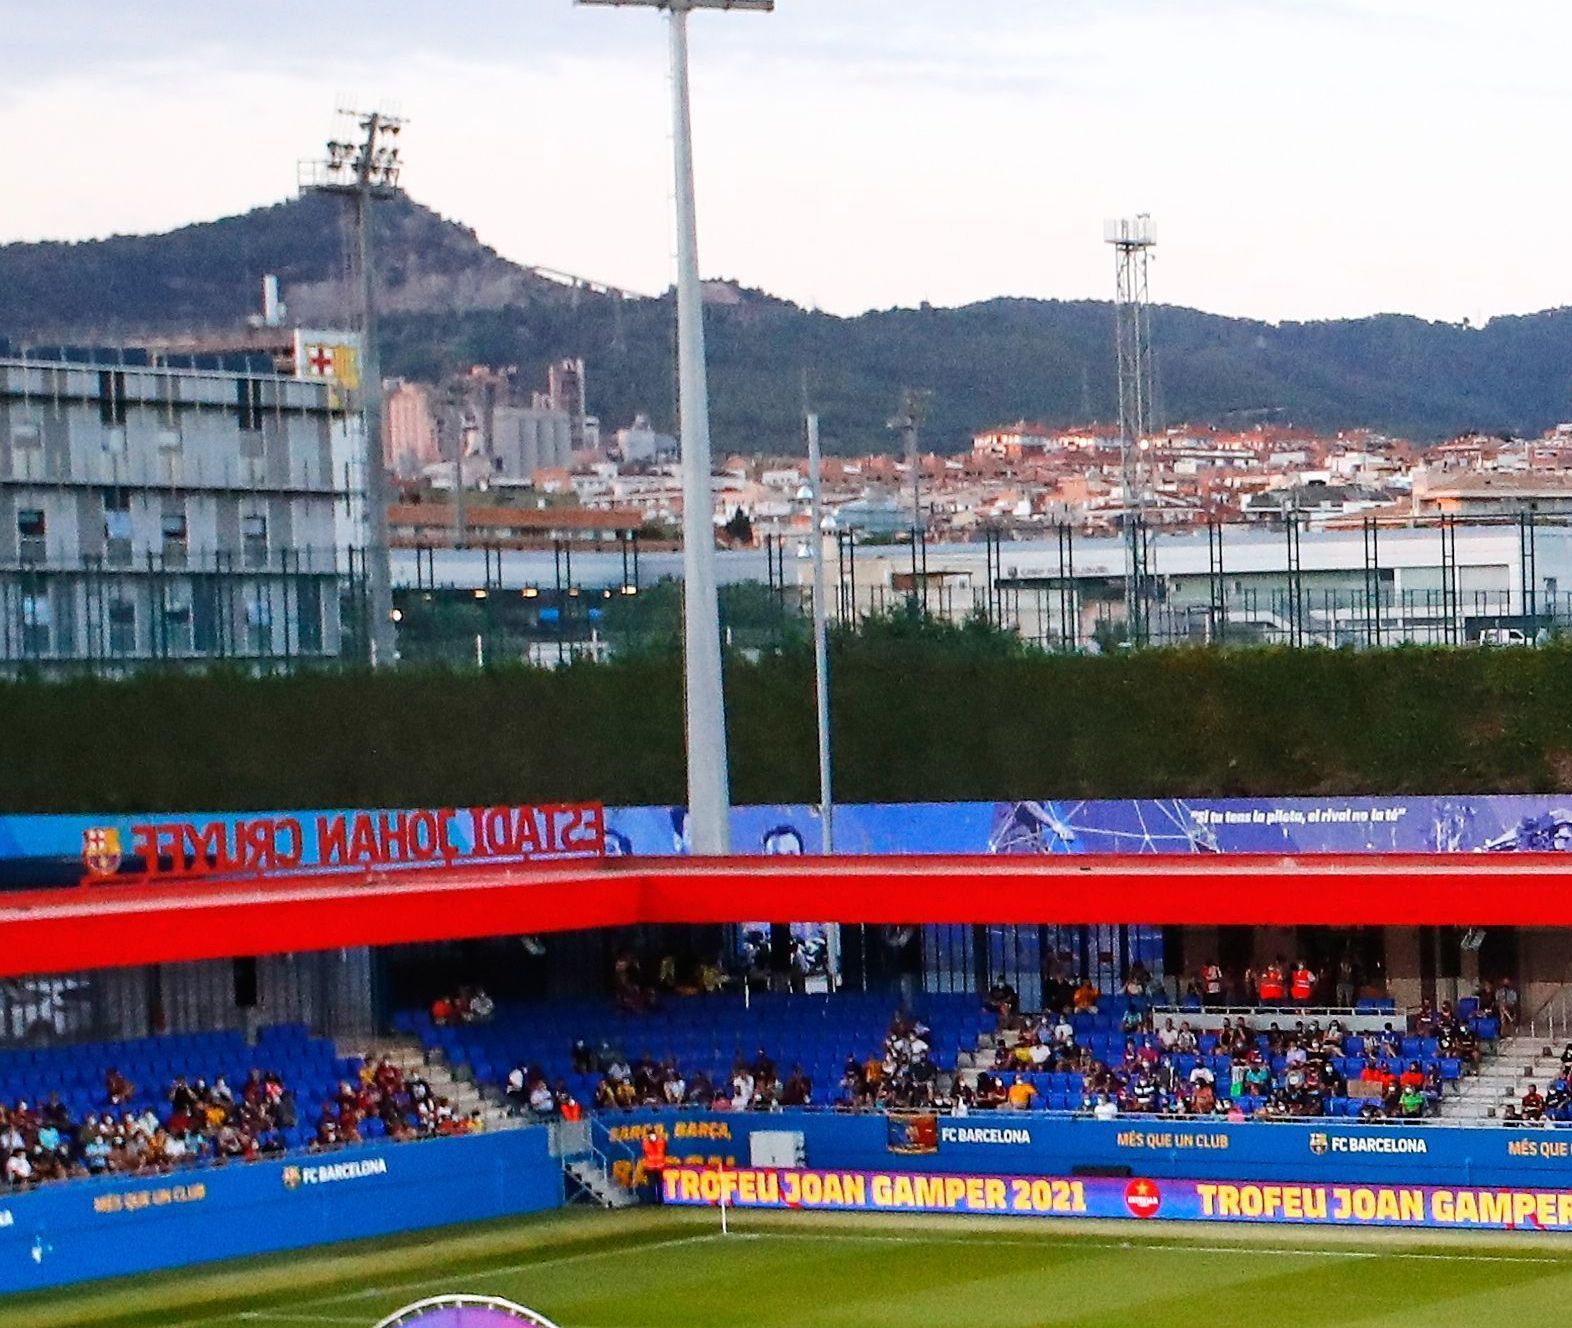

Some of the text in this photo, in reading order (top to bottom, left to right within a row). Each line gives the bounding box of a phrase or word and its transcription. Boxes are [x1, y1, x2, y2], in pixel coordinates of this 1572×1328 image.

[1224, 810, 1251, 823] tens
[1253, 809, 1266, 823] la
[1266, 809, 1306, 825] pilota,
[1307, 808, 1320, 823] el
[1321, 808, 1351, 822] rival
[1352, 810, 1368, 822] no
[1371, 808, 1384, 822] la
[942, 1127, 1031, 1144] FC BARCELONA
[1117, 1129, 1229, 1150] MÉS QUE UN CLUB
[1331, 1138, 1427, 1154] FC BARCELONA
[1508, 1138, 1538, 1156] MÉS
[1540, 1141, 1568, 1159] QUE
[319, 1158, 387, 1183] BARCELONA
[662, 1169, 778, 1202] TROFEU
[785, 1172, 866, 1205] JOAN
[871, 1175, 1006, 1211] GAMPER
[1012, 1179, 1087, 1212] 2021
[1197, 1184, 1327, 1219] TROFEU
[1333, 1187, 1427, 1221] JOAN
